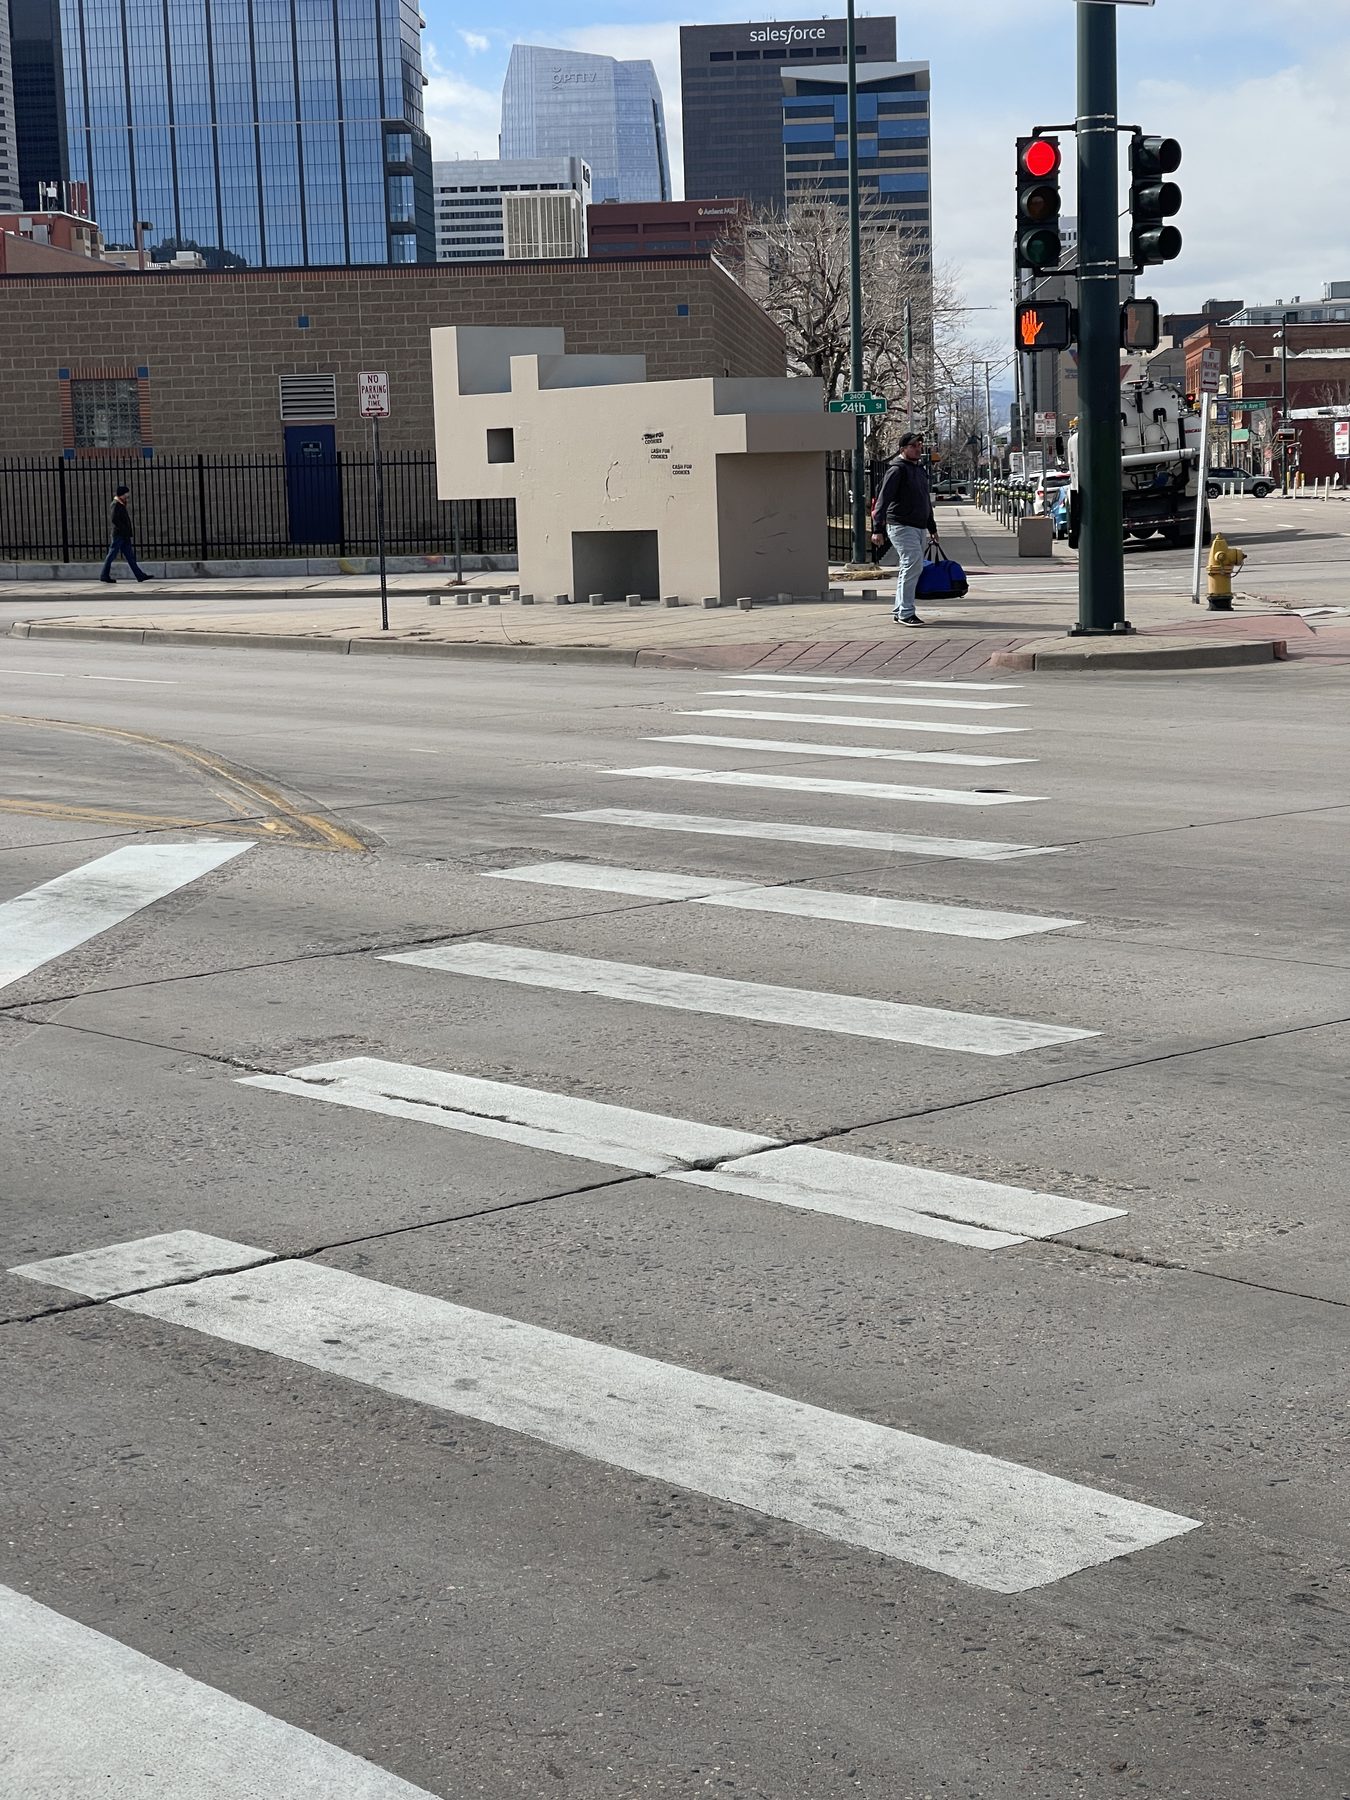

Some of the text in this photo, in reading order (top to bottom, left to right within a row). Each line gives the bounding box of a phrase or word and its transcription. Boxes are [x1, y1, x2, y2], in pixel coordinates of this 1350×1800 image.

[749, 25, 826, 45] salesforce
[553, 72, 597, 84] OPTIV
[367, 374, 379, 384] NO
[361, 384, 387, 394] PARKING
[840, 402, 866, 413] 24th
